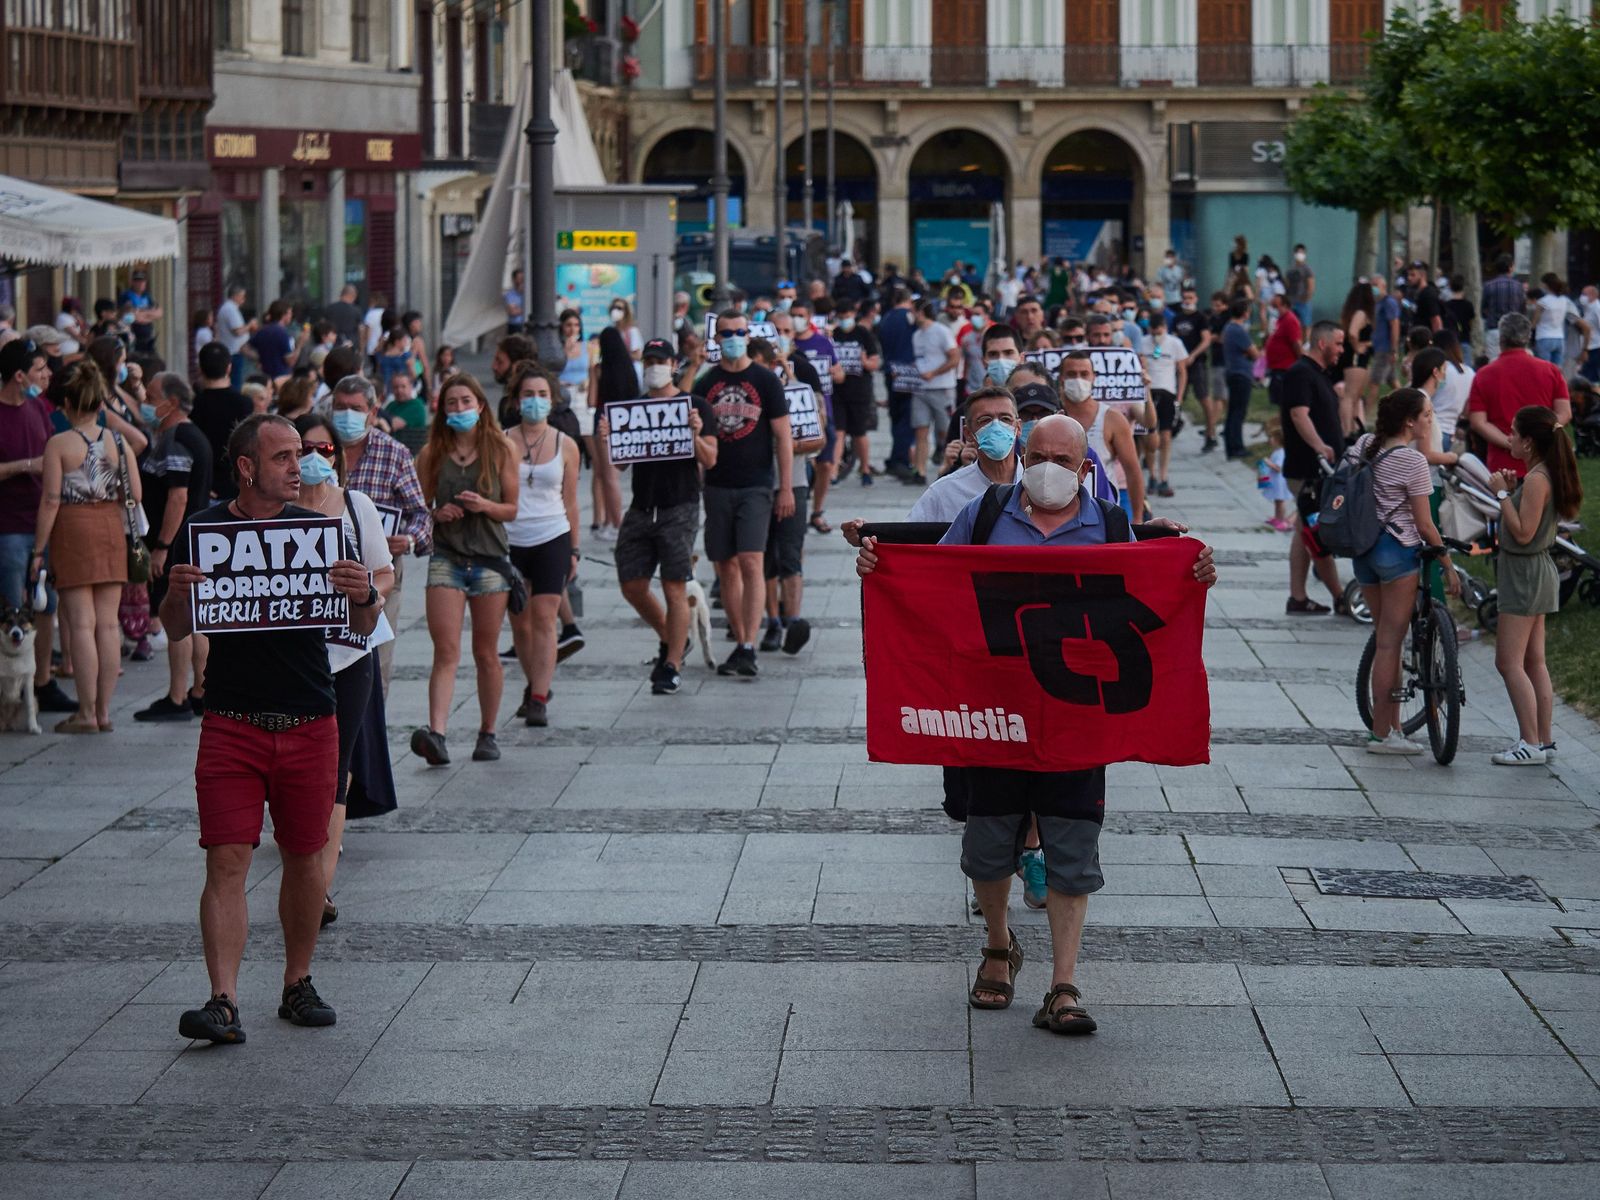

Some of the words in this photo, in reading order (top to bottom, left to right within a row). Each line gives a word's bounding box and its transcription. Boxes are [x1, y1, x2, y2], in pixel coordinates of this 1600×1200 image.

[580, 235, 630, 247] ONCE
[1090, 352, 1141, 373] ATXI
[610, 402, 688, 431] PATXI
[611, 428, 691, 446] BORROKAN
[612, 444, 647, 459] HERRIA
[651, 442, 670, 456] ERE
[198, 527, 338, 573] PATXI
[198, 600, 261, 624] HERRIA
[269, 599, 304, 621] ERE
[310, 597, 346, 619] BAI!
[900, 704, 1028, 743] amnistia
